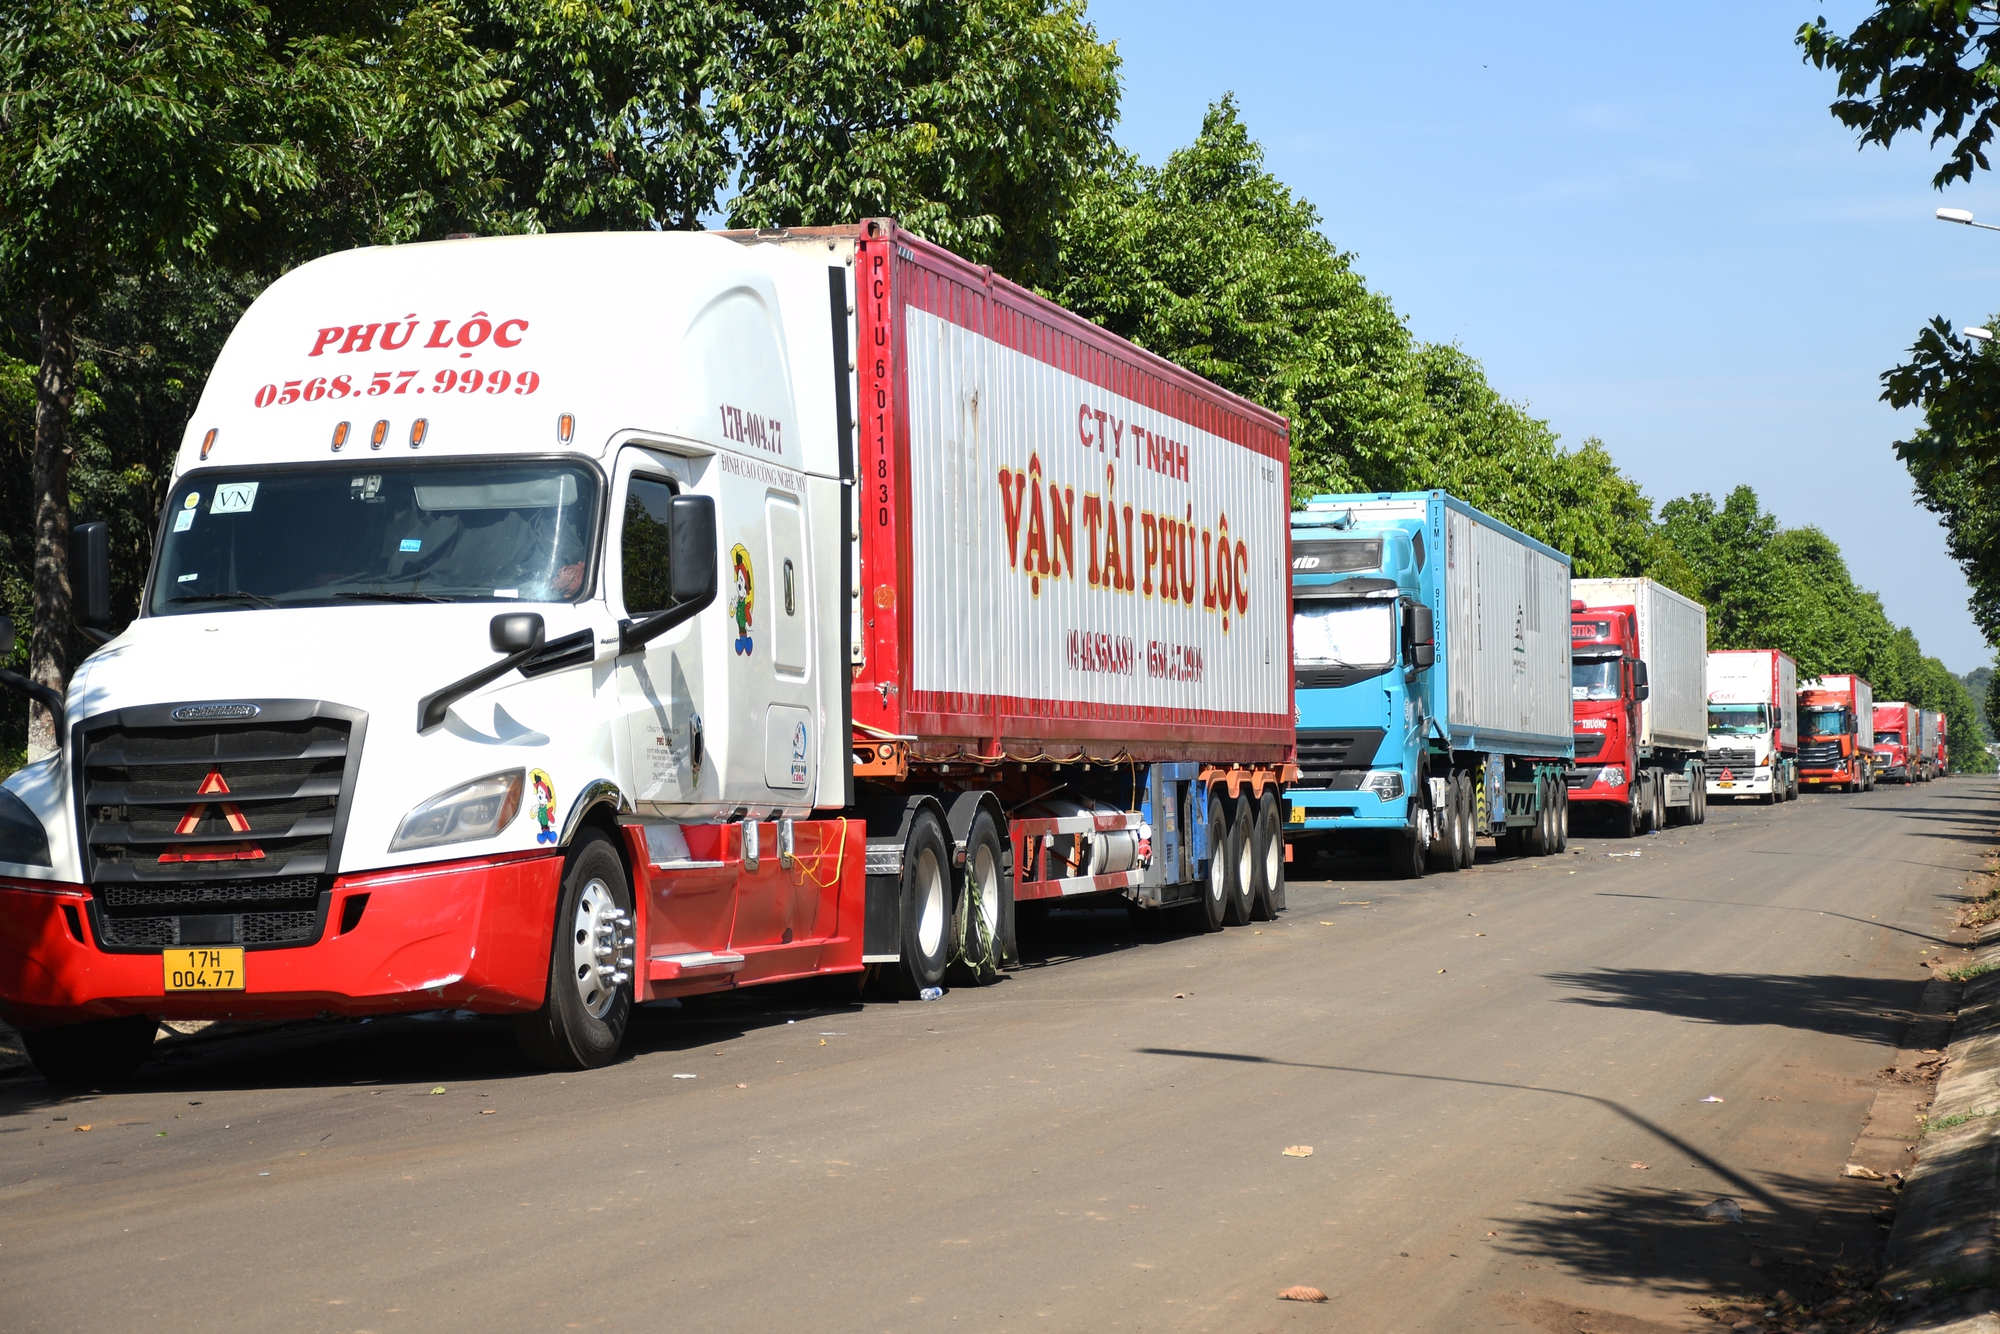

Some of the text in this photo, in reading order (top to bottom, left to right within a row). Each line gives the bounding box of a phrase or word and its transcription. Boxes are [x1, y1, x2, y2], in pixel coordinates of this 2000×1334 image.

[308, 310, 529, 358] PHÚ LỘC
[254, 368, 540, 409] 0568.57.9999
[874, 255, 888, 526] PCIU 6011830
[720, 403, 782, 455] 17H-004.77
[1078, 403, 1189, 483] CTY TNHH
[741, 460, 757, 479] CAO
[757, 462, 777, 486] CÔNG
[221, 490, 251, 507] VN
[998, 448, 1248, 636] VẬN TẢI PHÚ LỘC
[172, 970, 235, 988] 004.77
[188, 950, 221, 968] 17H
